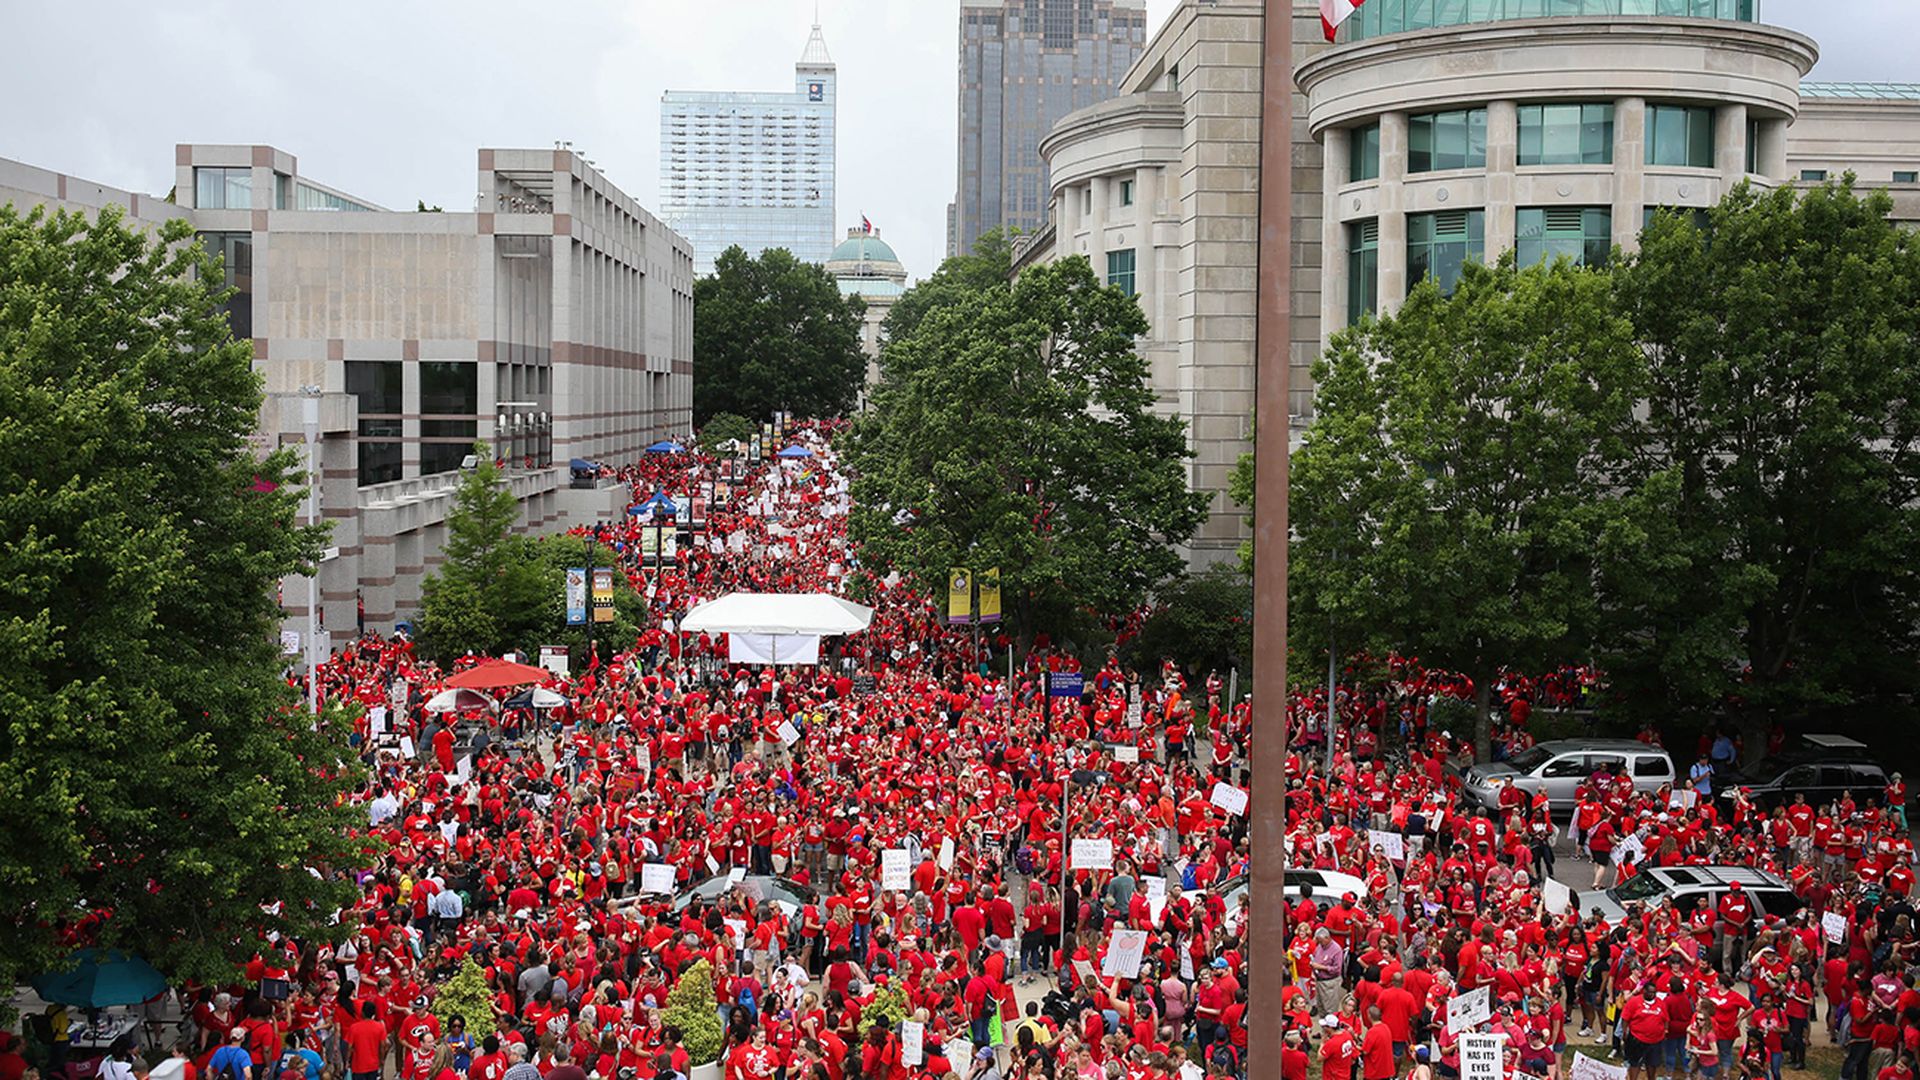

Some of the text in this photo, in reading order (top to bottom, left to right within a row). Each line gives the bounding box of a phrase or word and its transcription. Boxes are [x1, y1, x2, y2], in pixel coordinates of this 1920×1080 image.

[1467, 1039, 1496, 1048] HISTORY
[1467, 1051, 1496, 1060] HAS ITS
[1471, 1063, 1491, 1072] EYES
